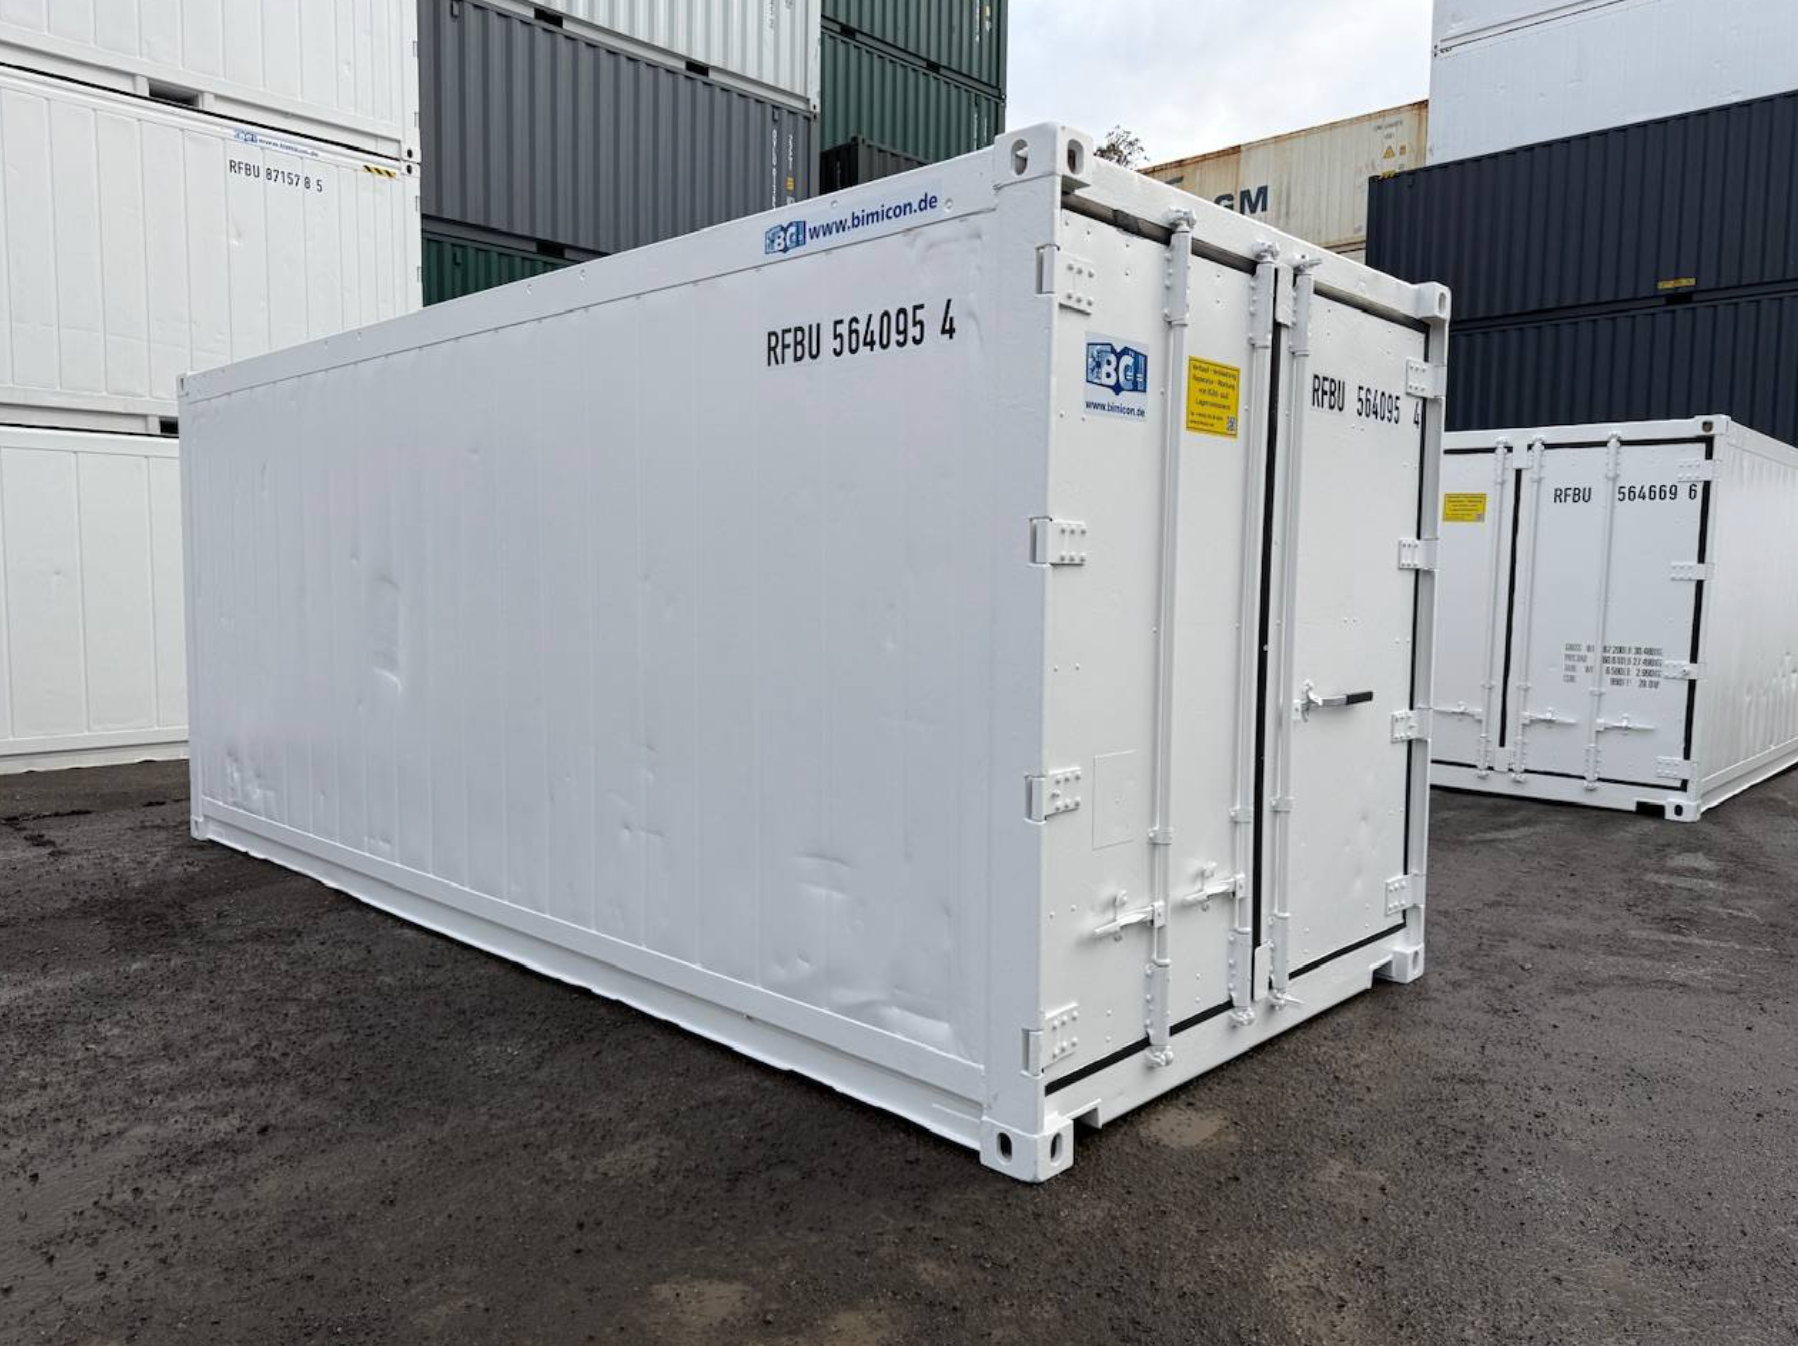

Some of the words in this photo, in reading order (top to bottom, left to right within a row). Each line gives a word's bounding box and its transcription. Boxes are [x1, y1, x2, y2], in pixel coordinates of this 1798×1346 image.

[229, 159, 260, 178] RFBU
[808, 193, 938, 240] www.bimicon.de
[767, 322, 821, 367] RFBU
[832, 303, 925, 358] 564095
[940, 298, 956, 340] 4
[1312, 373, 1346, 412] RFBU
[1357, 385, 1400, 425] 564095
[1413, 401, 1420, 430] 4
[1553, 487, 1592, 503] RFBU
[1618, 484, 1678, 502] 564669
[1688, 483, 1698, 501] 6
